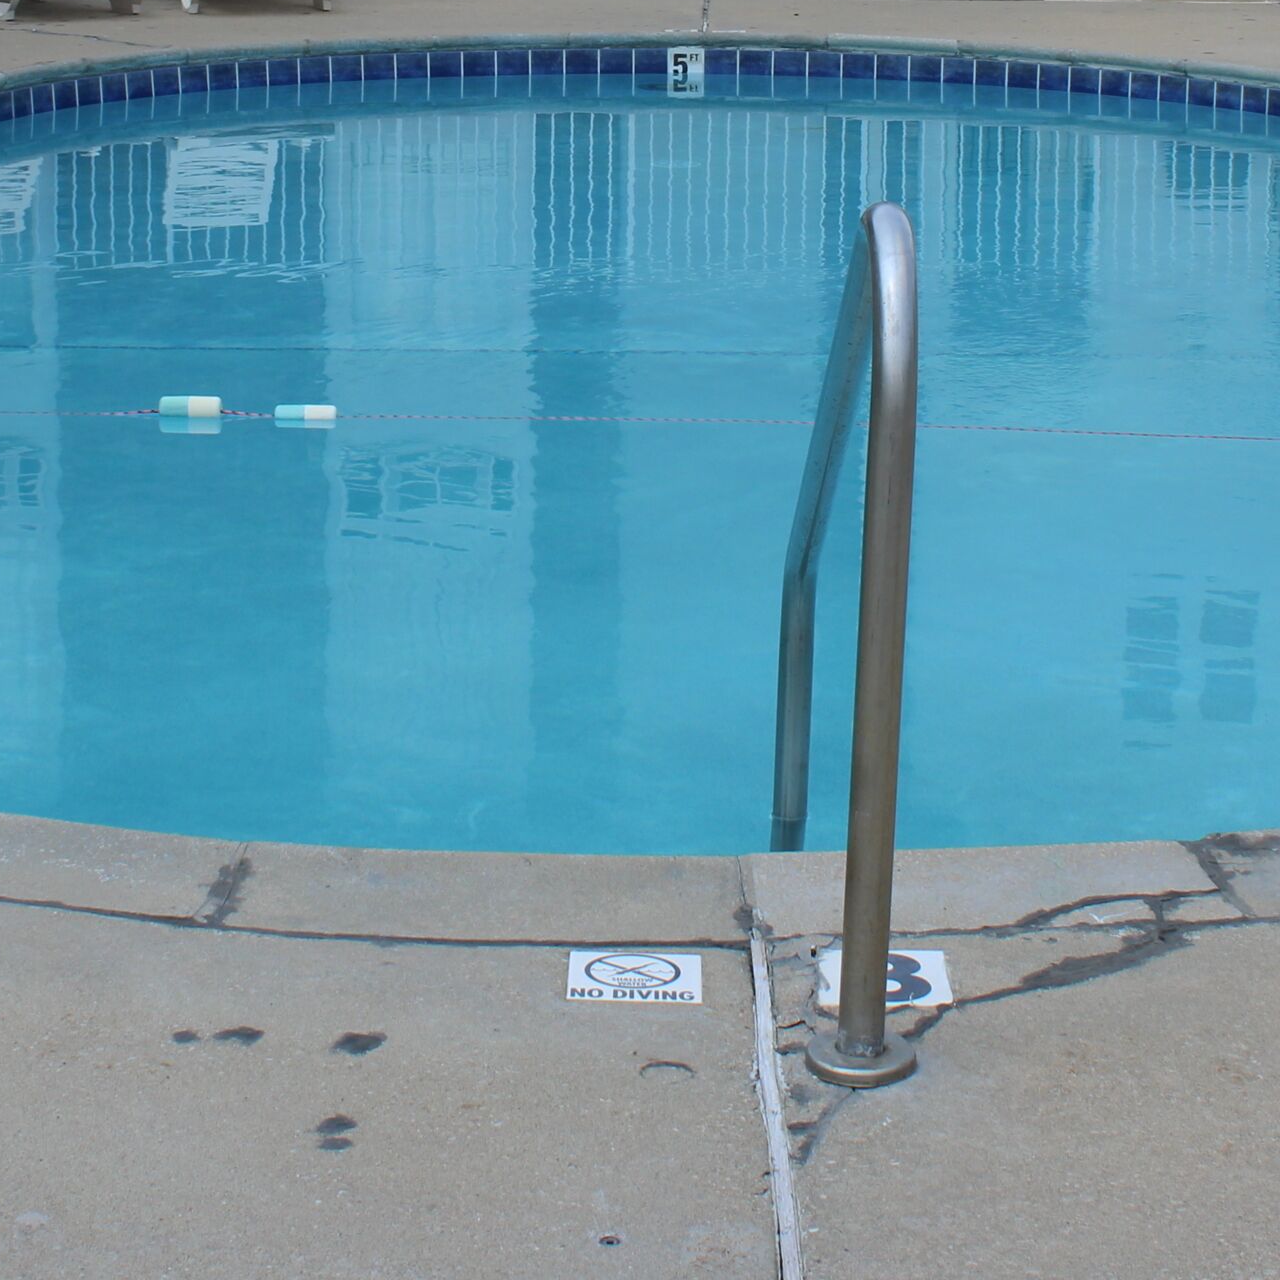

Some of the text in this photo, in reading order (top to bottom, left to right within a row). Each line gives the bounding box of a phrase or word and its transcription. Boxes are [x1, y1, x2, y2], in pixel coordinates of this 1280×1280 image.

[672, 53, 700, 74] 5 FT
[570, 987, 695, 1001] NO DIVING
